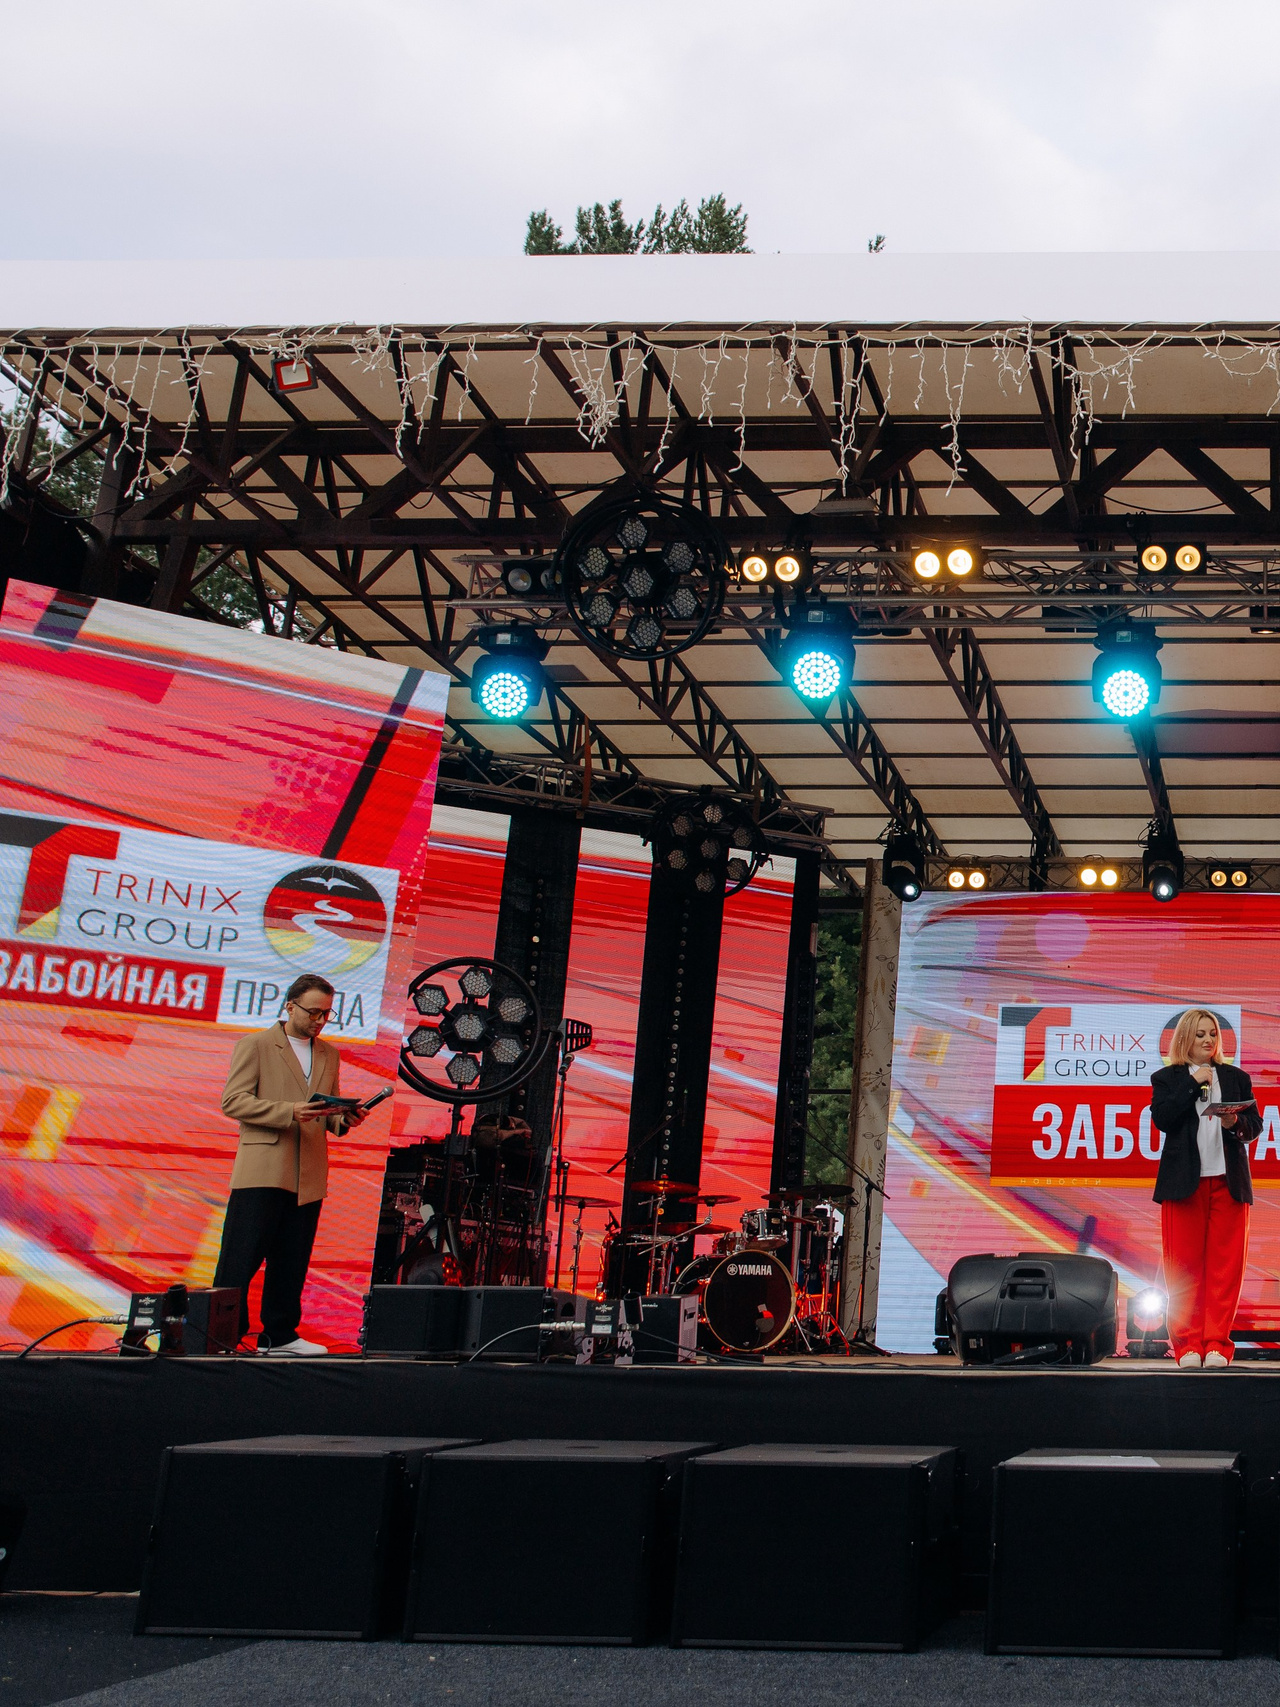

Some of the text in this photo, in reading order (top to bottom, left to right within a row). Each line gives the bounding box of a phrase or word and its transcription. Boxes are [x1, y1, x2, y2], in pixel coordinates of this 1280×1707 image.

[86, 868, 243, 915] TRINIX
[76, 908, 240, 952] GROUP
[232, 979, 366, 1031] ПРДА
[1055, 1033, 1145, 1052] TRINIX
[1054, 1059, 1147, 1077] GROUP
[738, 1264, 773, 1276] YAMAHA
